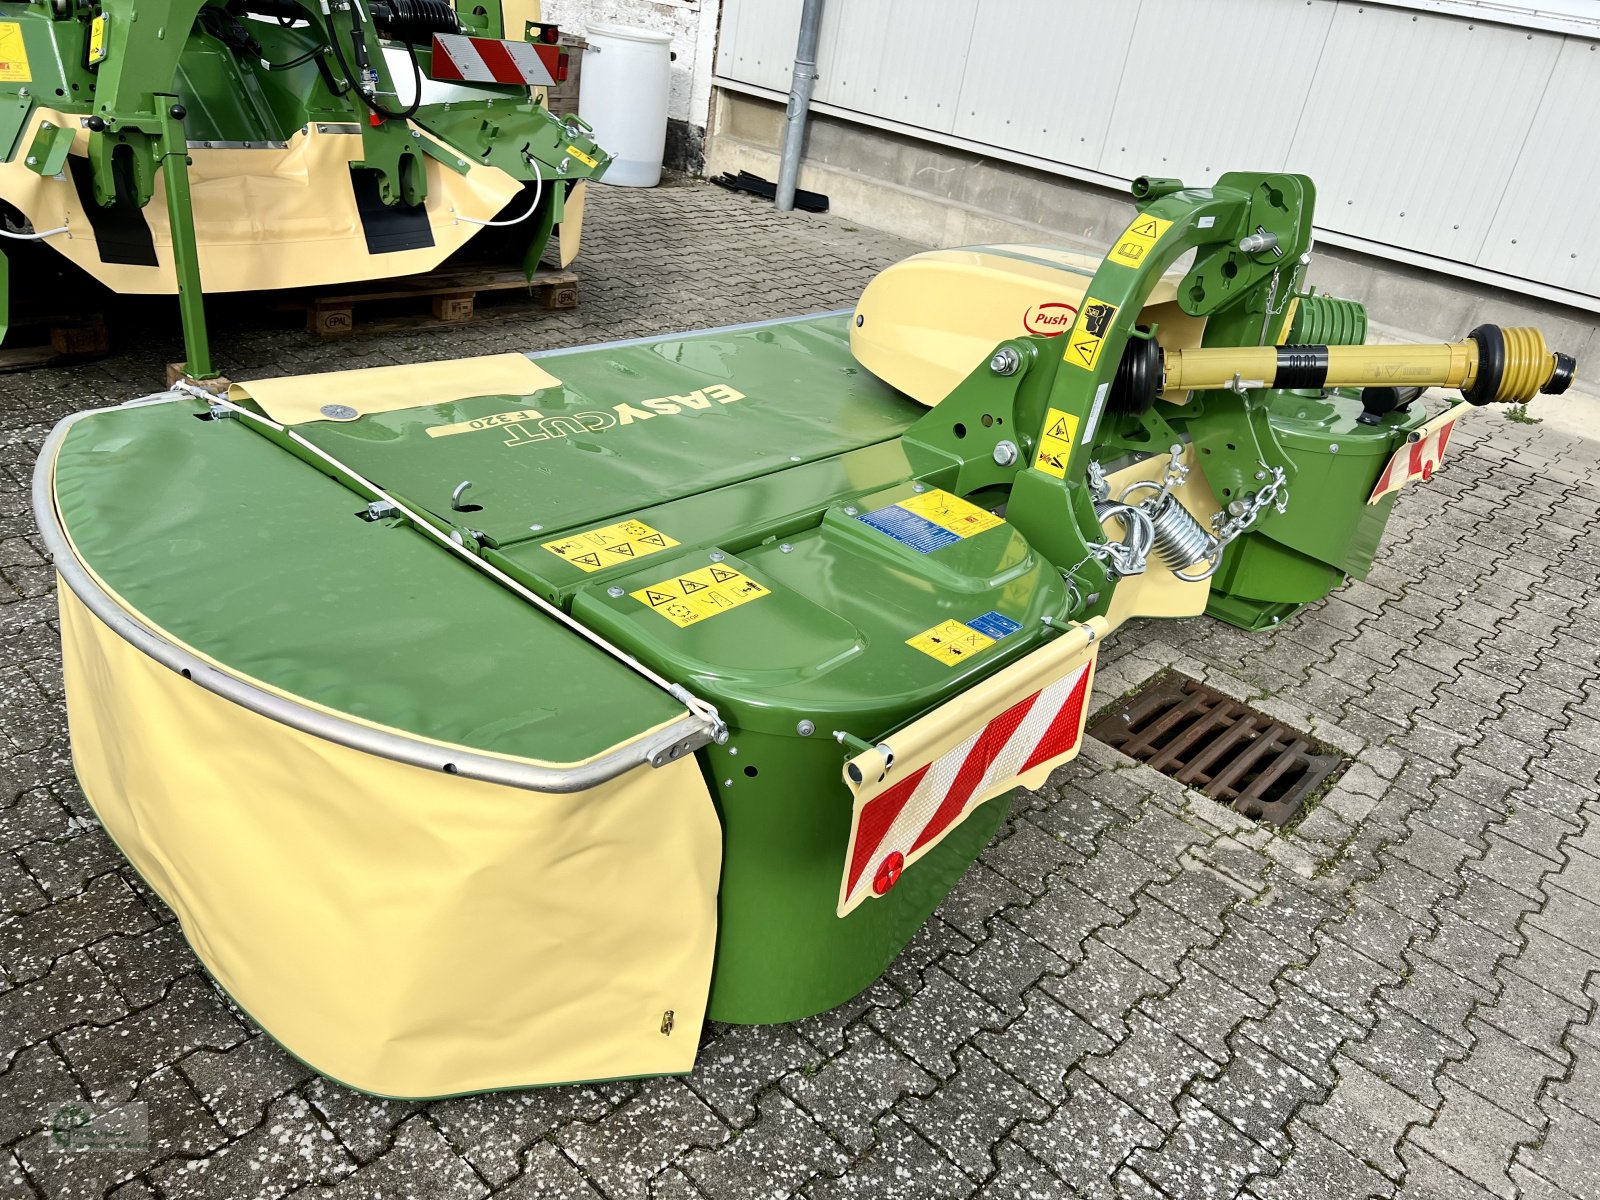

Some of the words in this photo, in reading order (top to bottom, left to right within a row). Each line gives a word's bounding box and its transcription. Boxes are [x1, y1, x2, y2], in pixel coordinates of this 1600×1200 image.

[1034, 313, 1068, 325] Push
[516, 411, 531, 420] F
[469, 413, 513, 430] 320
[682, 614, 699, 623] STOP
